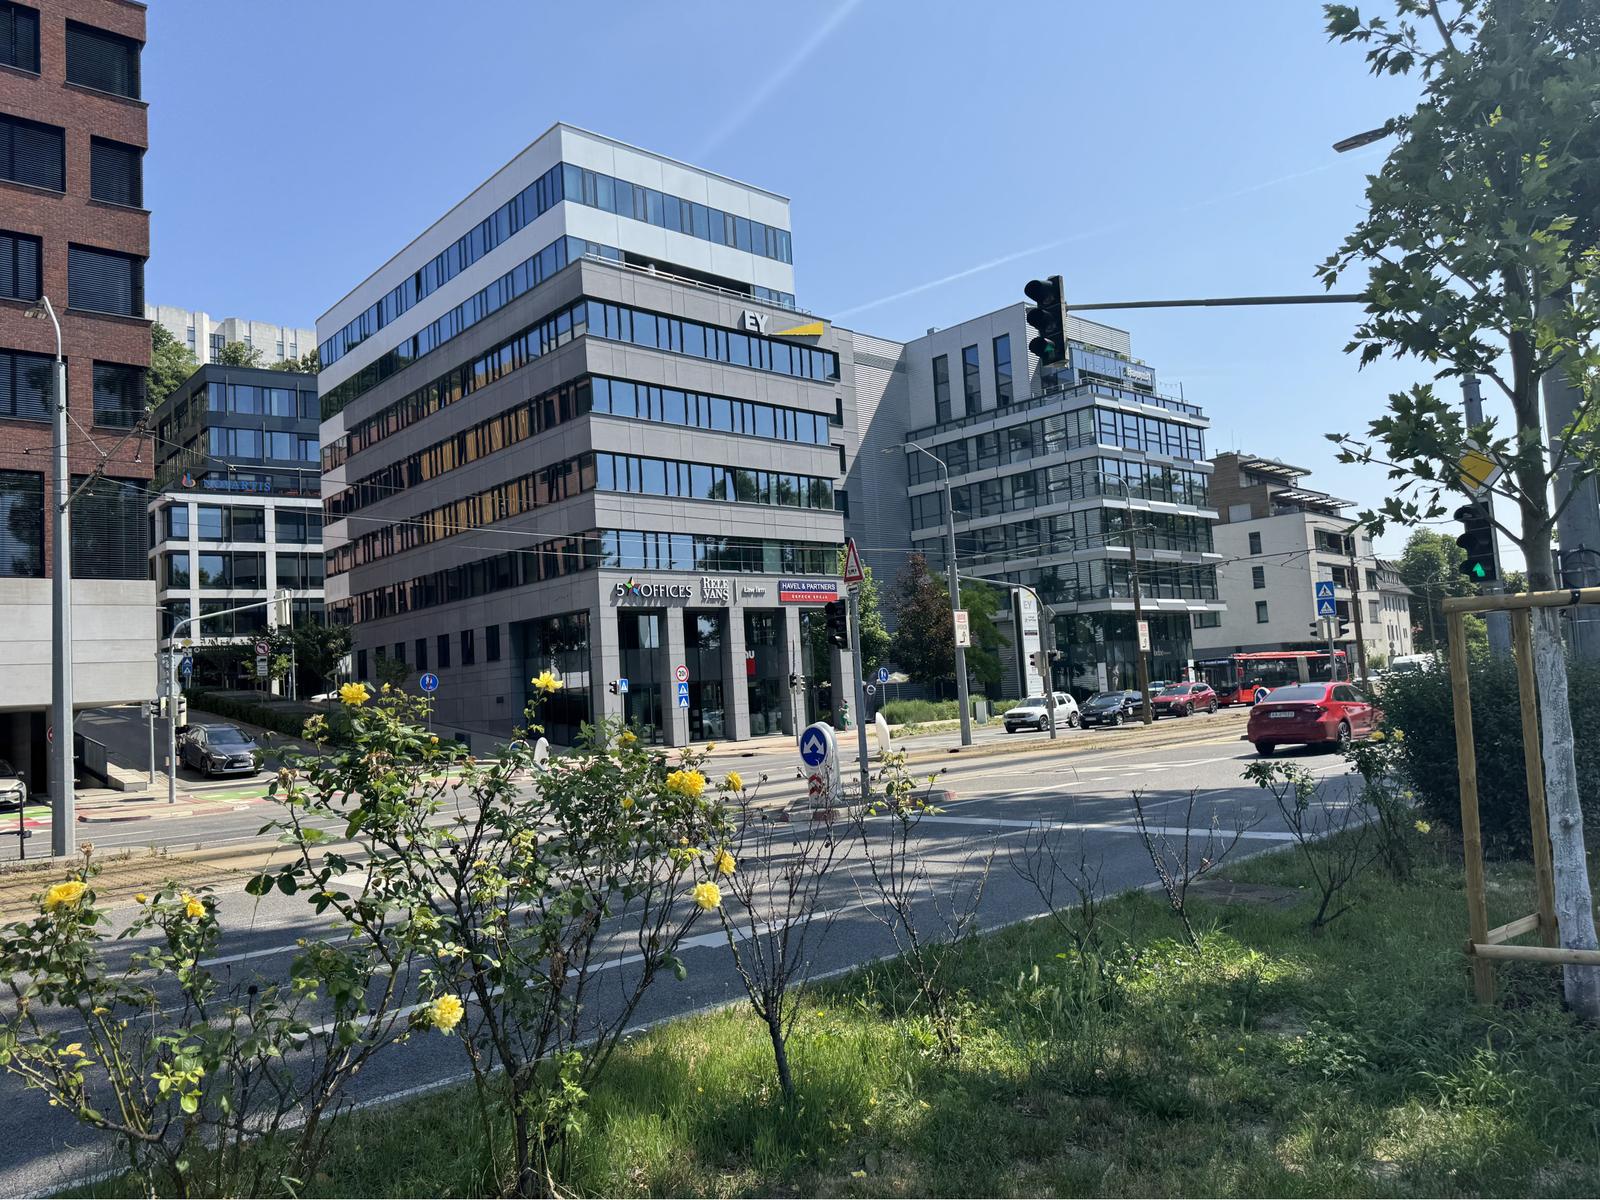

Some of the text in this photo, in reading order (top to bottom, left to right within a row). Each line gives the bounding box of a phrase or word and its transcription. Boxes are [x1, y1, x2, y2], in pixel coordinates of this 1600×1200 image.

[744, 309, 769, 333] EY
[203, 479, 271, 492] NOVARTIS
[616, 583, 693, 598] 5 OFFICES
[782, 582, 801, 590] HAVEL
[806, 583, 836, 591] PARTNERS
[702, 588, 730, 601] VANS
[1024, 600, 1032, 609] EY
